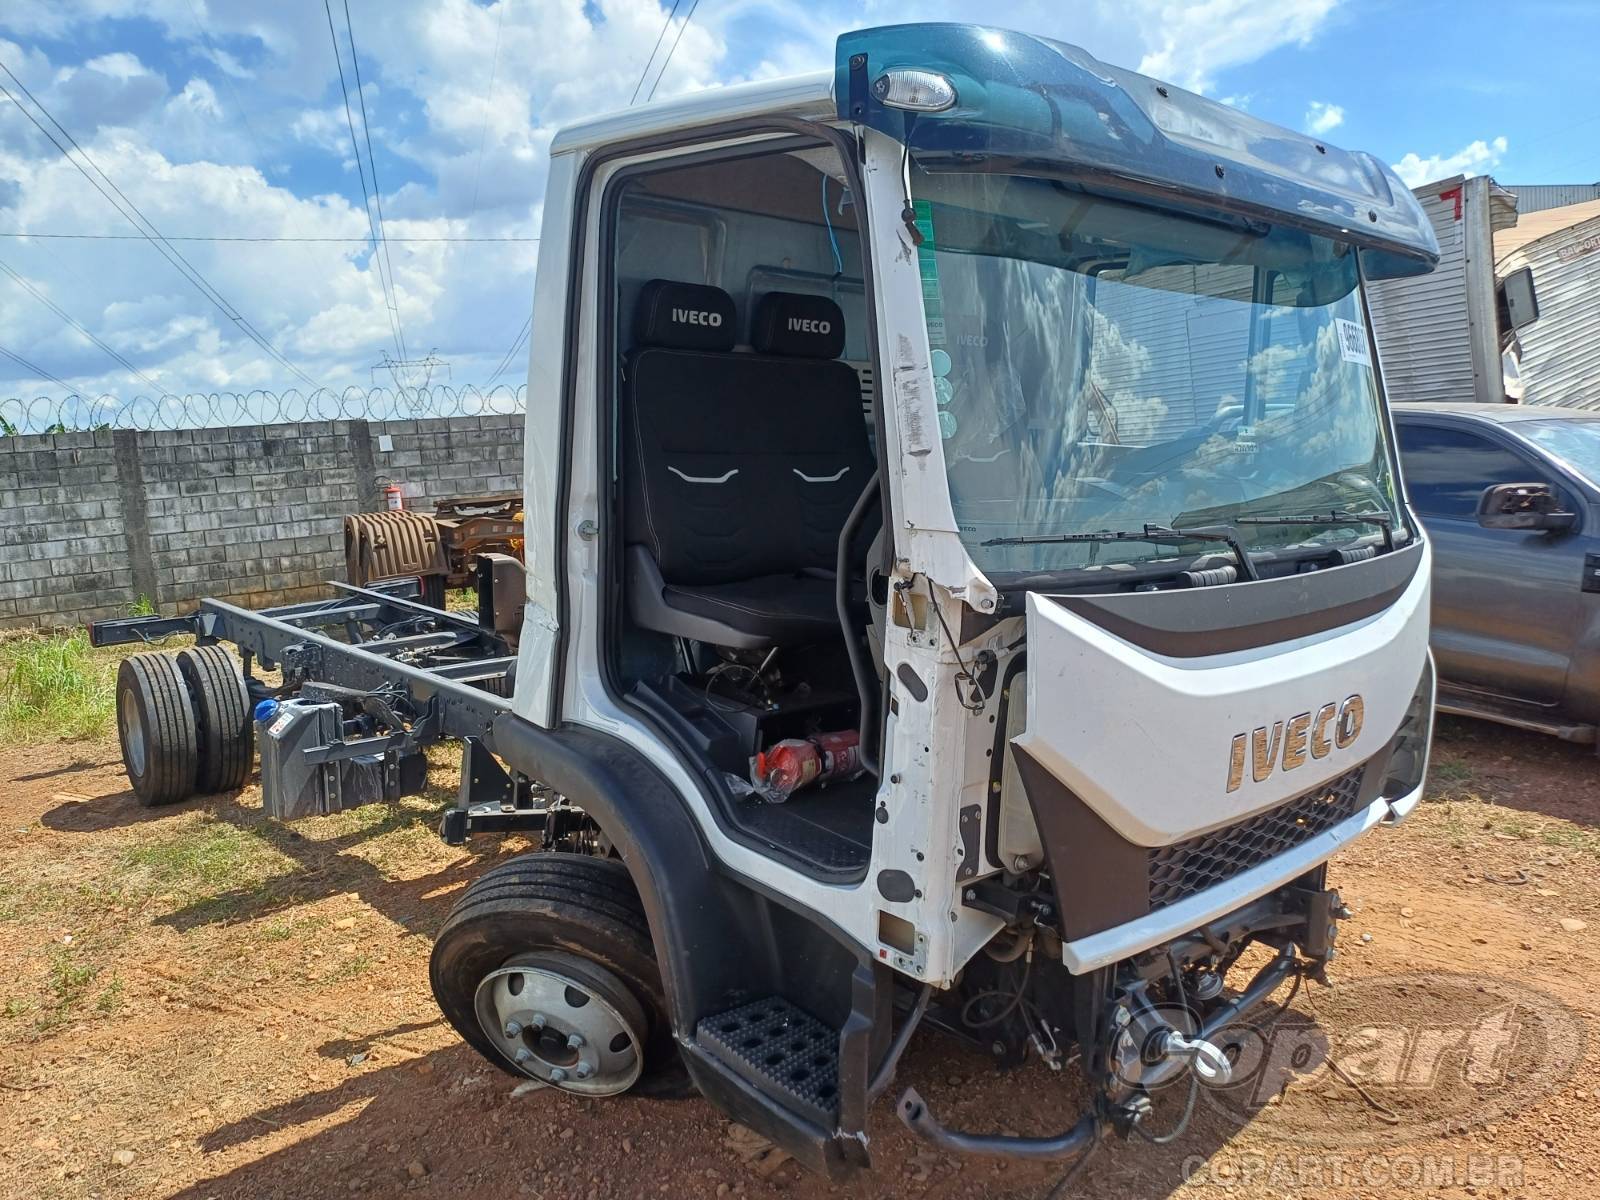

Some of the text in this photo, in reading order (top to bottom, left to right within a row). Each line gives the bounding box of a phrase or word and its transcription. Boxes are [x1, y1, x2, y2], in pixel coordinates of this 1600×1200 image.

[672, 308, 722, 327] IVECO
[788, 317, 831, 334] IVECO
[956, 335, 989, 347] IVECO
[1226, 694, 1364, 793] IVECO
